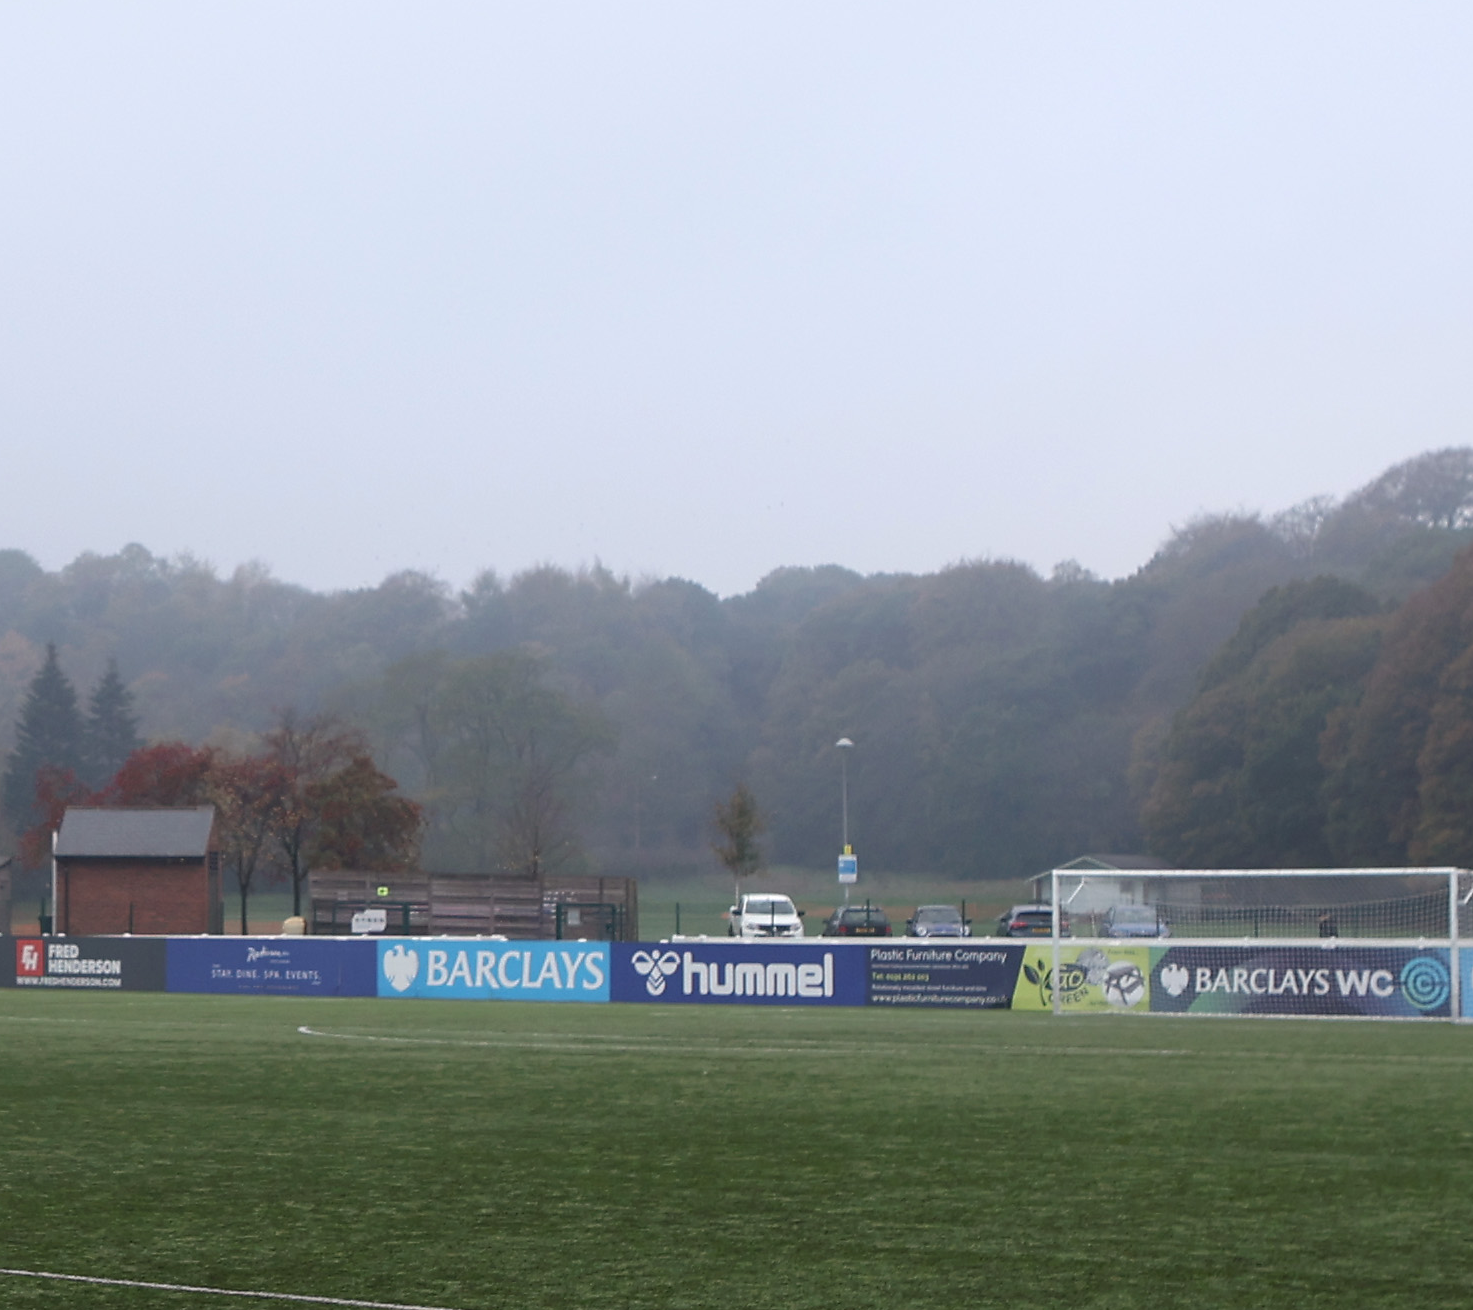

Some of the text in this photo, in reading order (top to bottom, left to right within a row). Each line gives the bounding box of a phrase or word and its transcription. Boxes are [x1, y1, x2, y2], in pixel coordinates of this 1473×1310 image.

[48, 944, 79, 958] FRED
[870, 949, 1007, 964] Plastic Furniture Company
[48, 959, 121, 974] HENDERSON
[426, 950, 605, 991] BARCLAYS
[683, 951, 833, 997] hummel
[1195, 968, 1394, 996] BARCLAYS WC
